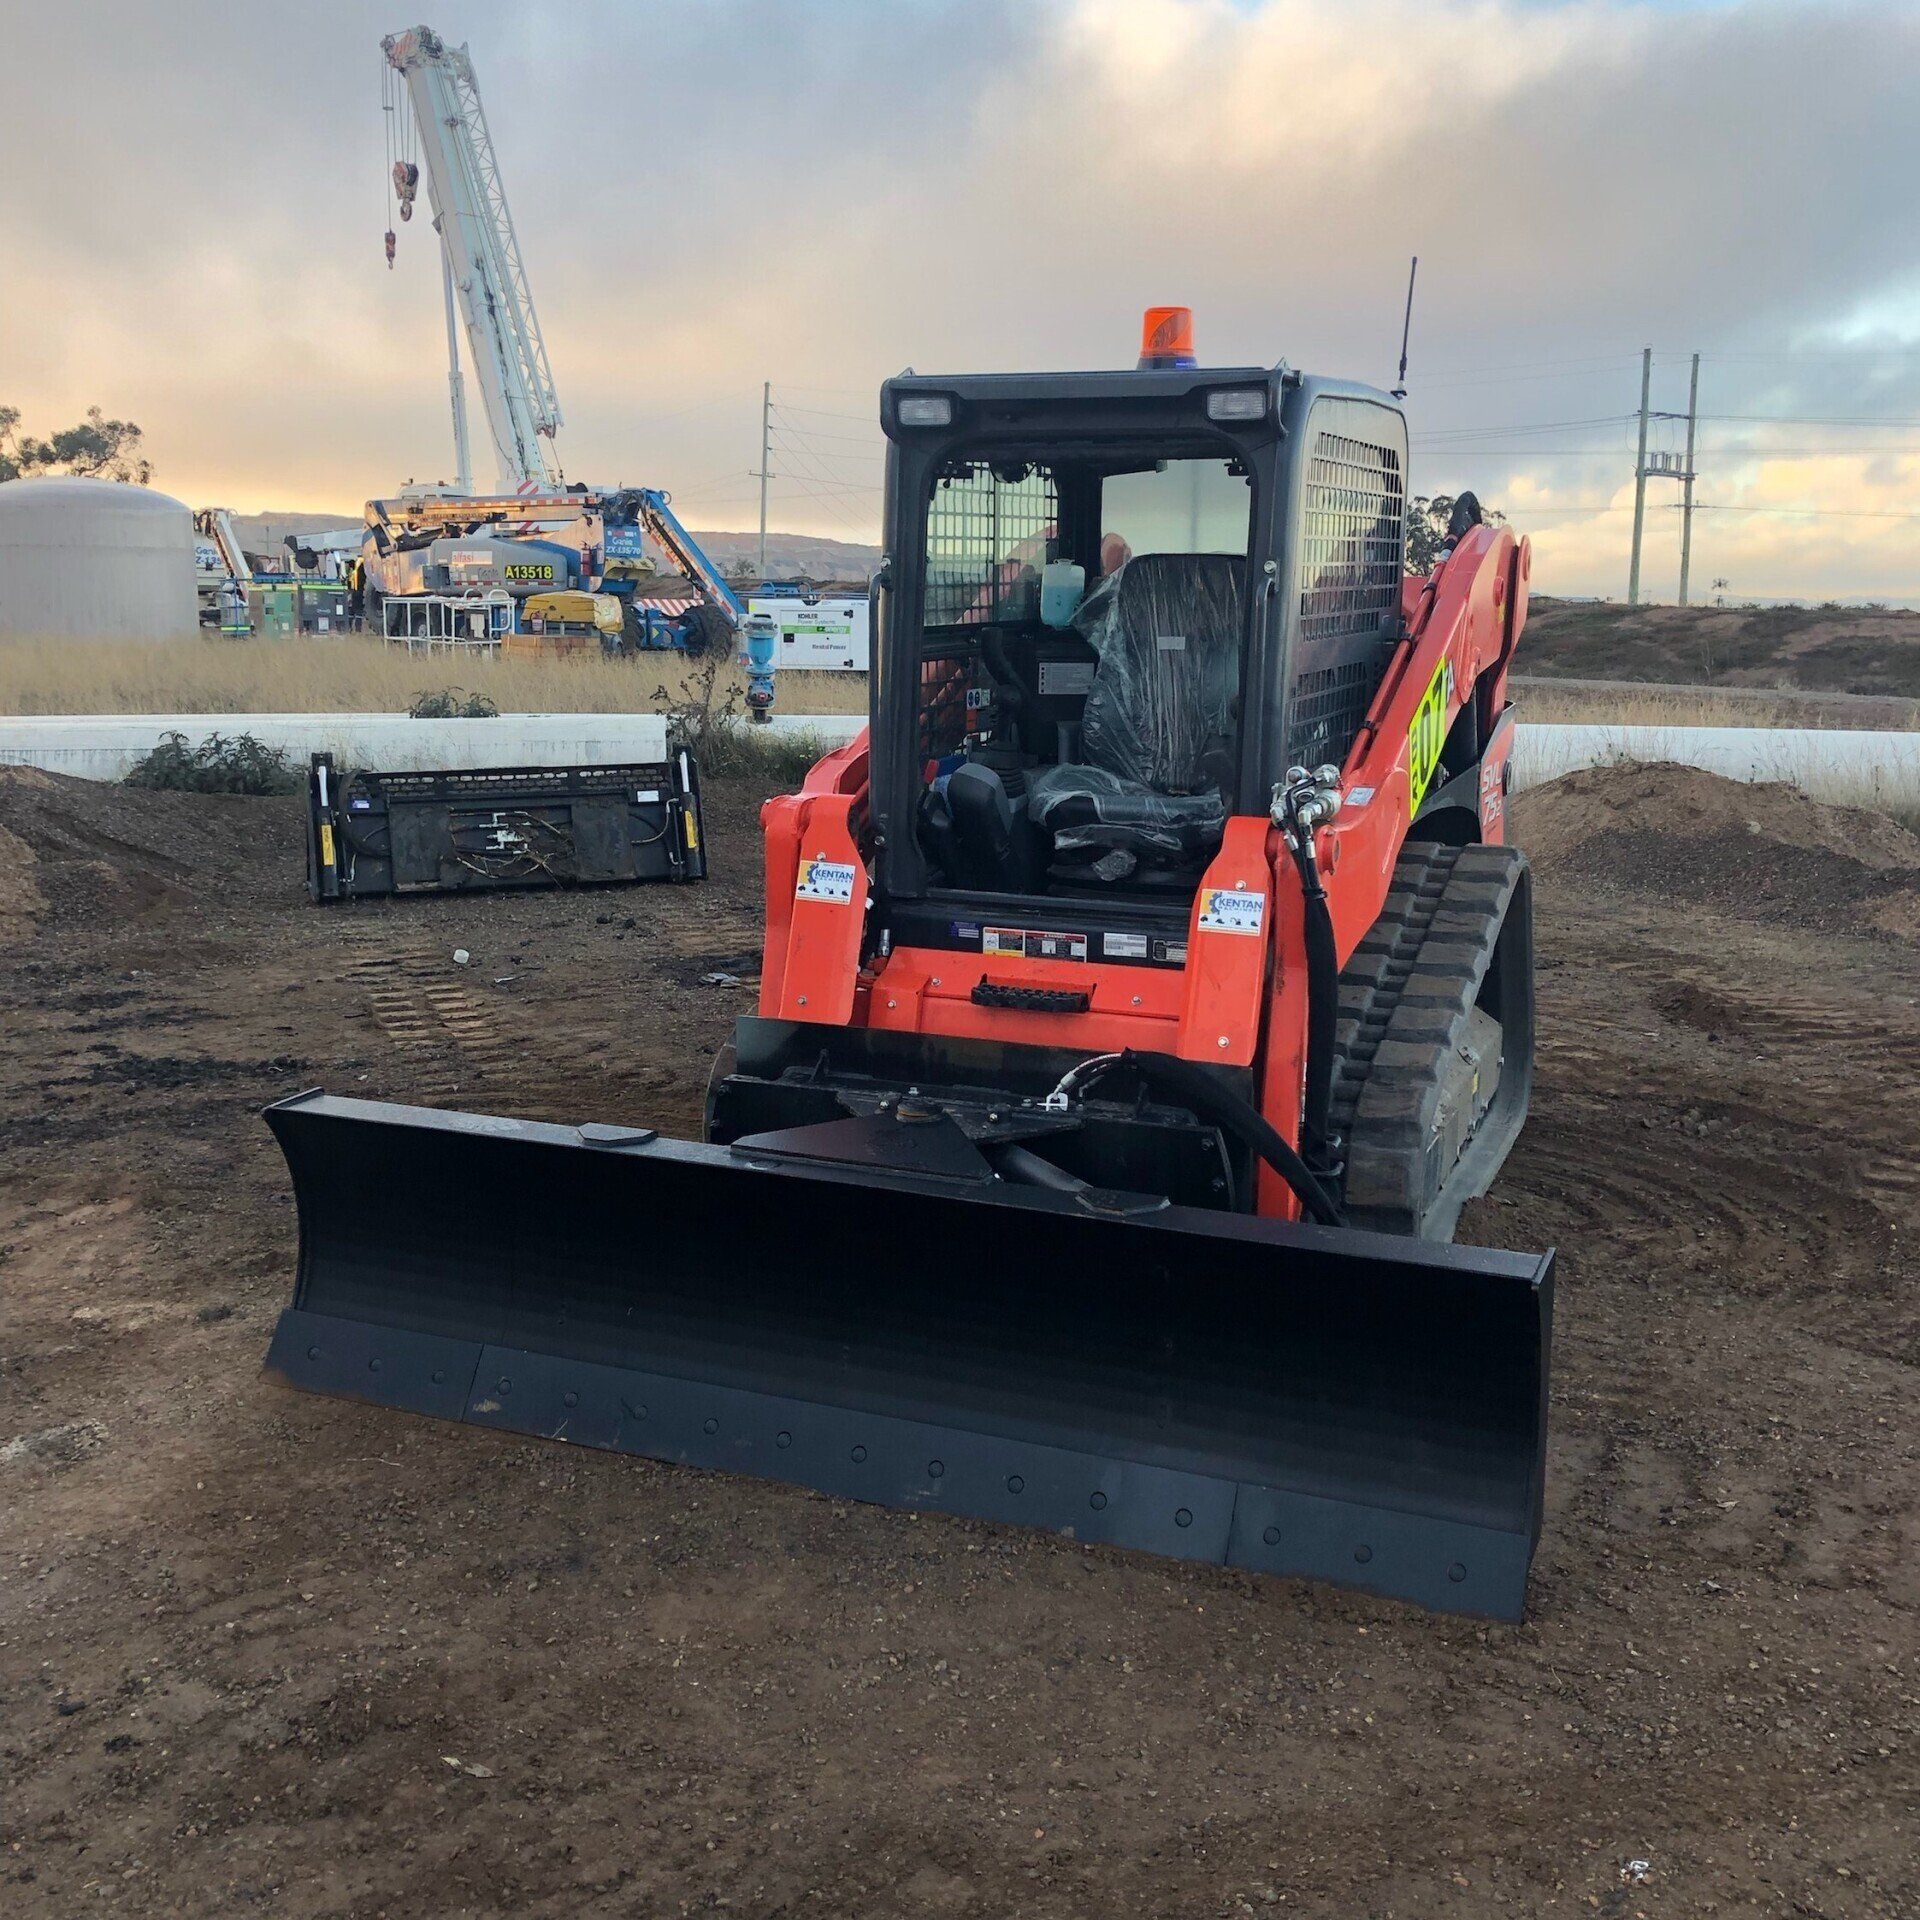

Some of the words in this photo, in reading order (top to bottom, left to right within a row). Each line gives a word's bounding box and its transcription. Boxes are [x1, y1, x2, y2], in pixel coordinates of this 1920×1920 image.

[452, 551, 474, 563] alfasi
[505, 566, 552, 579] A13518
[1481, 760, 1502, 794] SVL
[815, 869, 854, 880] KENTAN
[1219, 898, 1263, 909] KENTAN
